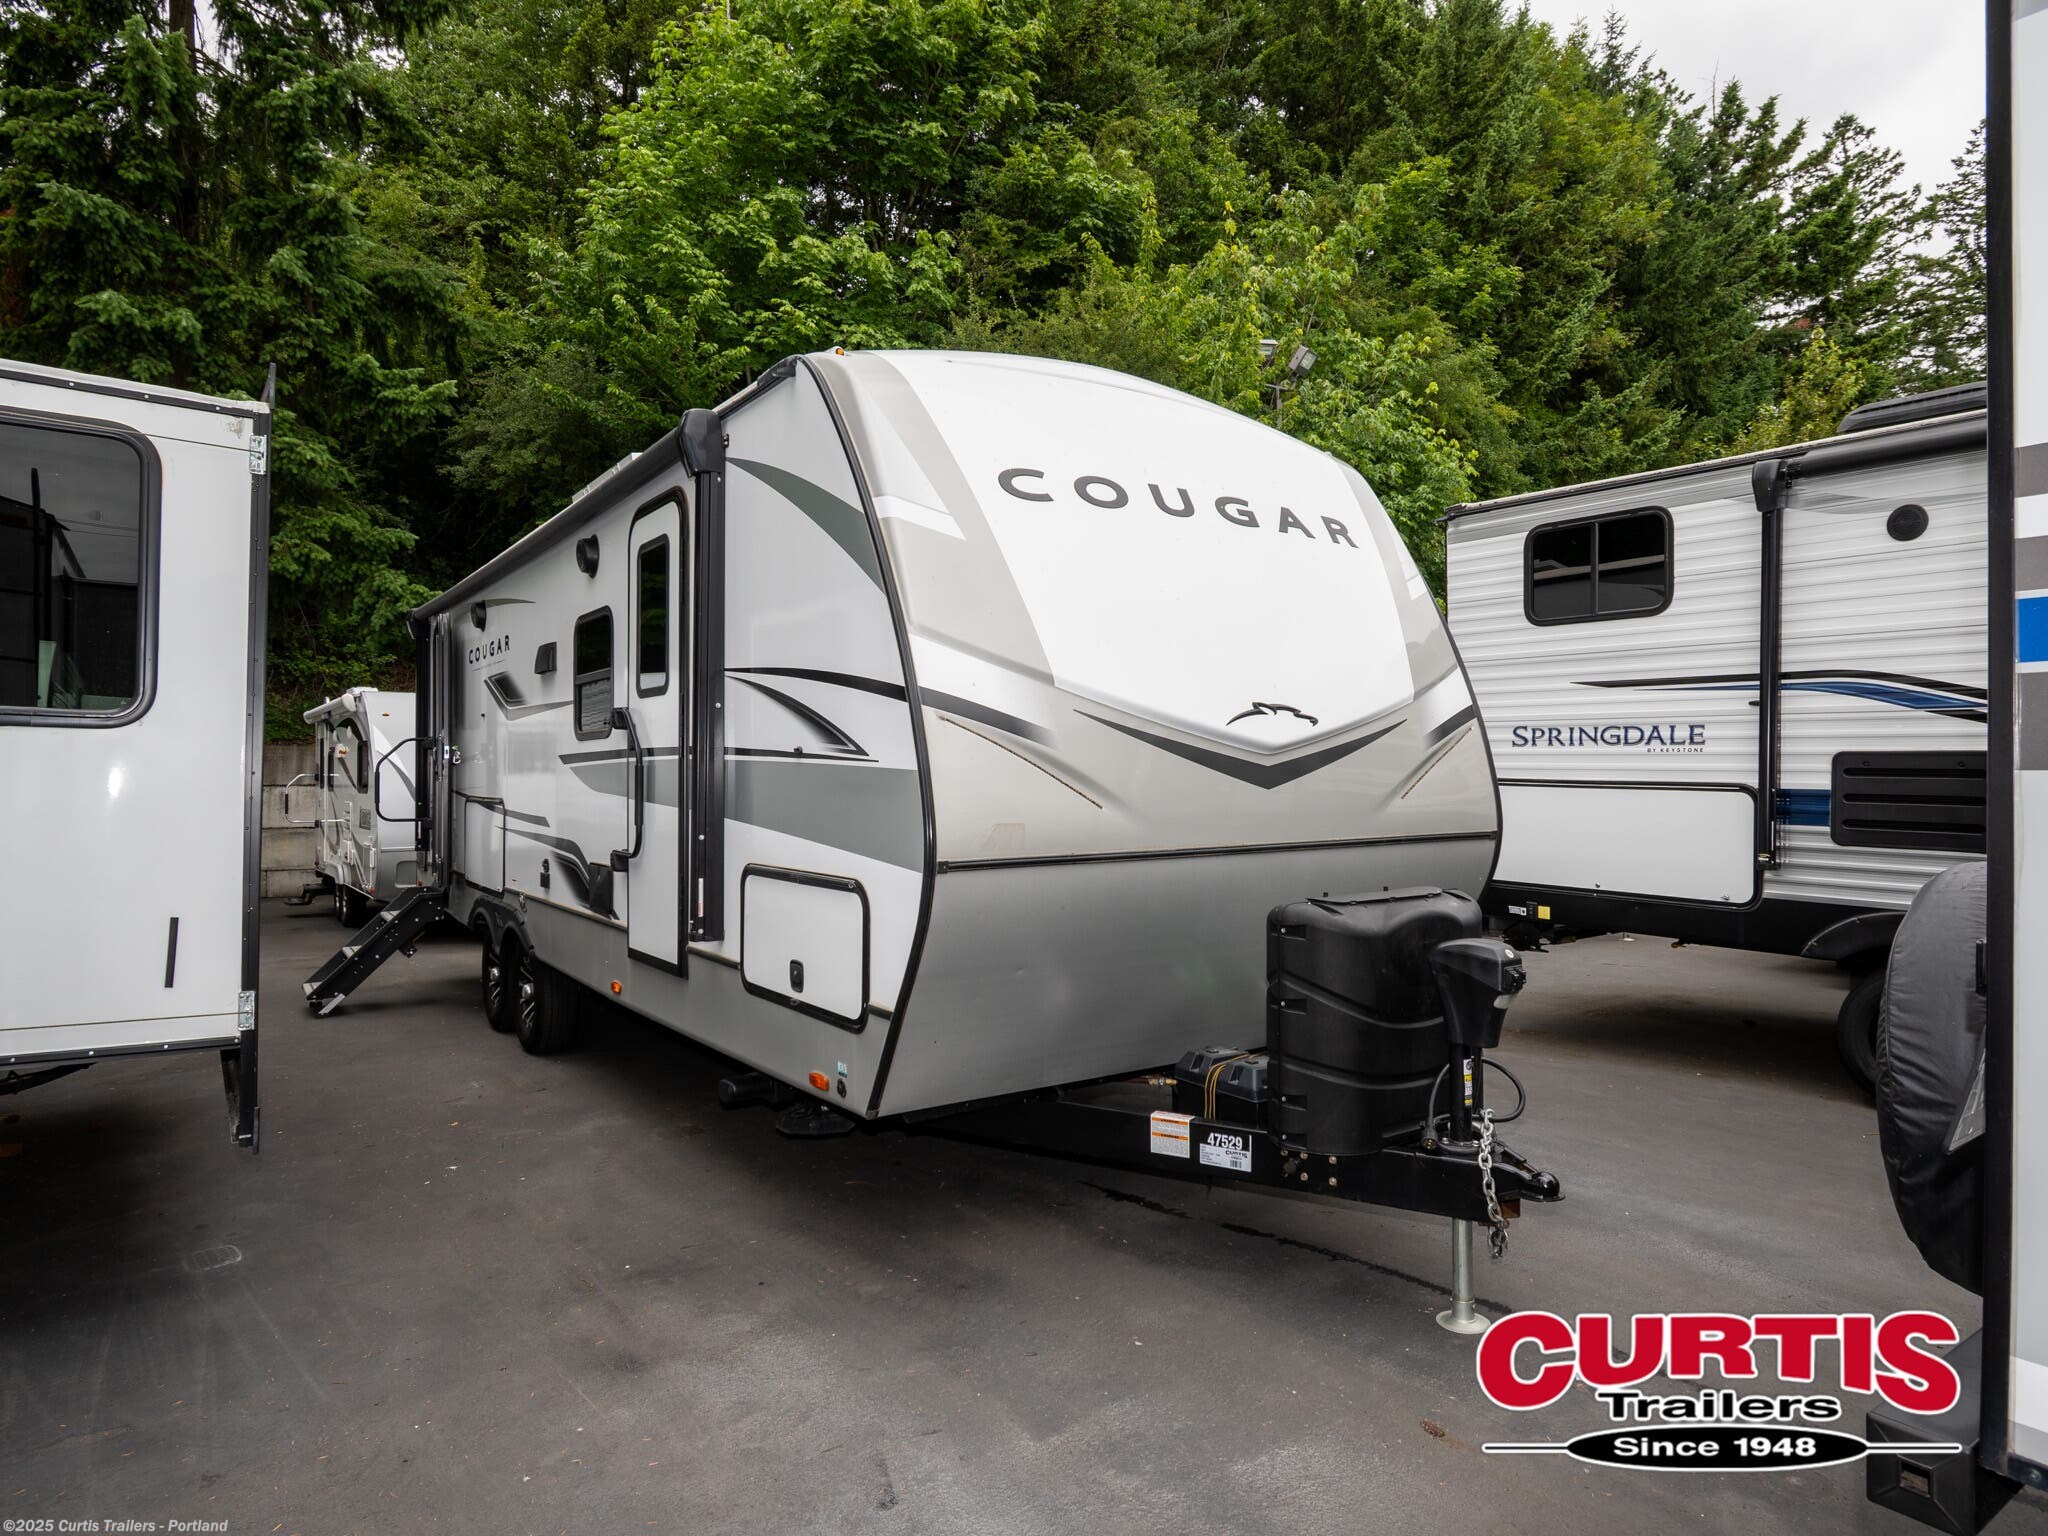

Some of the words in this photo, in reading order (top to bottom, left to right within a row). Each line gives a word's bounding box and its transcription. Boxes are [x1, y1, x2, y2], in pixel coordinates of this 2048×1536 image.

[997, 467, 1359, 549] COUGAR
[469, 635, 510, 664] COUGAR
[1512, 724, 1705, 747] SPRINGDALE
[1208, 1132, 1242, 1150] 47529
